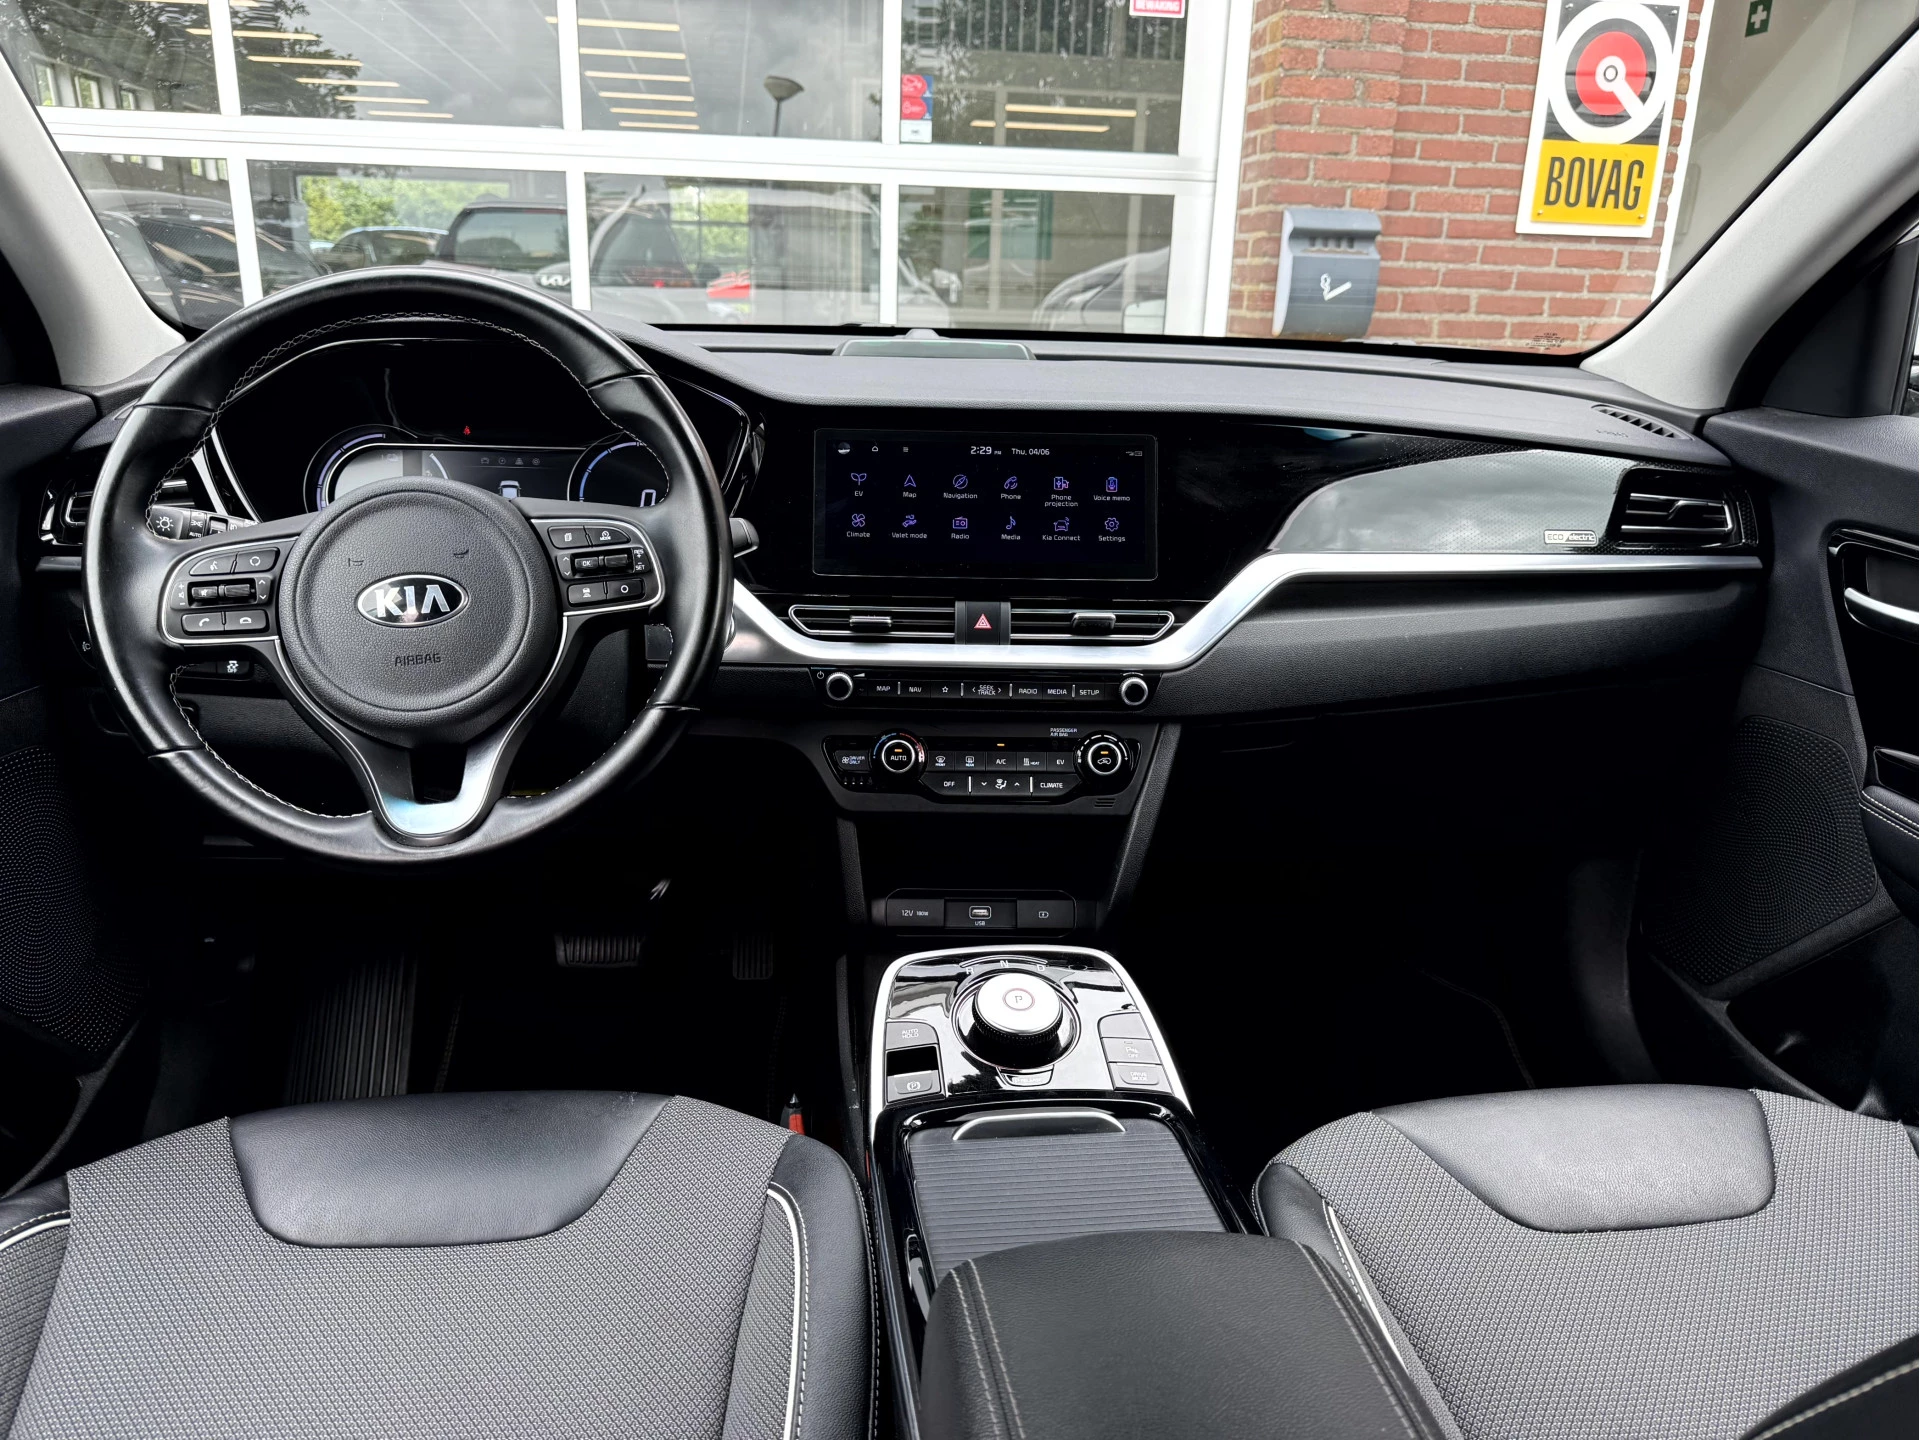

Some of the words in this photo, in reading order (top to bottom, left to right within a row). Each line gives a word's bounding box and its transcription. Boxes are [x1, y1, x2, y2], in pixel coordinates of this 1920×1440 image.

[1544, 156, 1645, 211] BOVAG
[970, 446, 992, 455] 2:29
[374, 584, 450, 618] KIA
[394, 652, 441, 667] AIRBAG
[1000, 960, 1009, 968] N
[965, 967, 974, 975] R
[1015, 995, 1023, 1004] P
